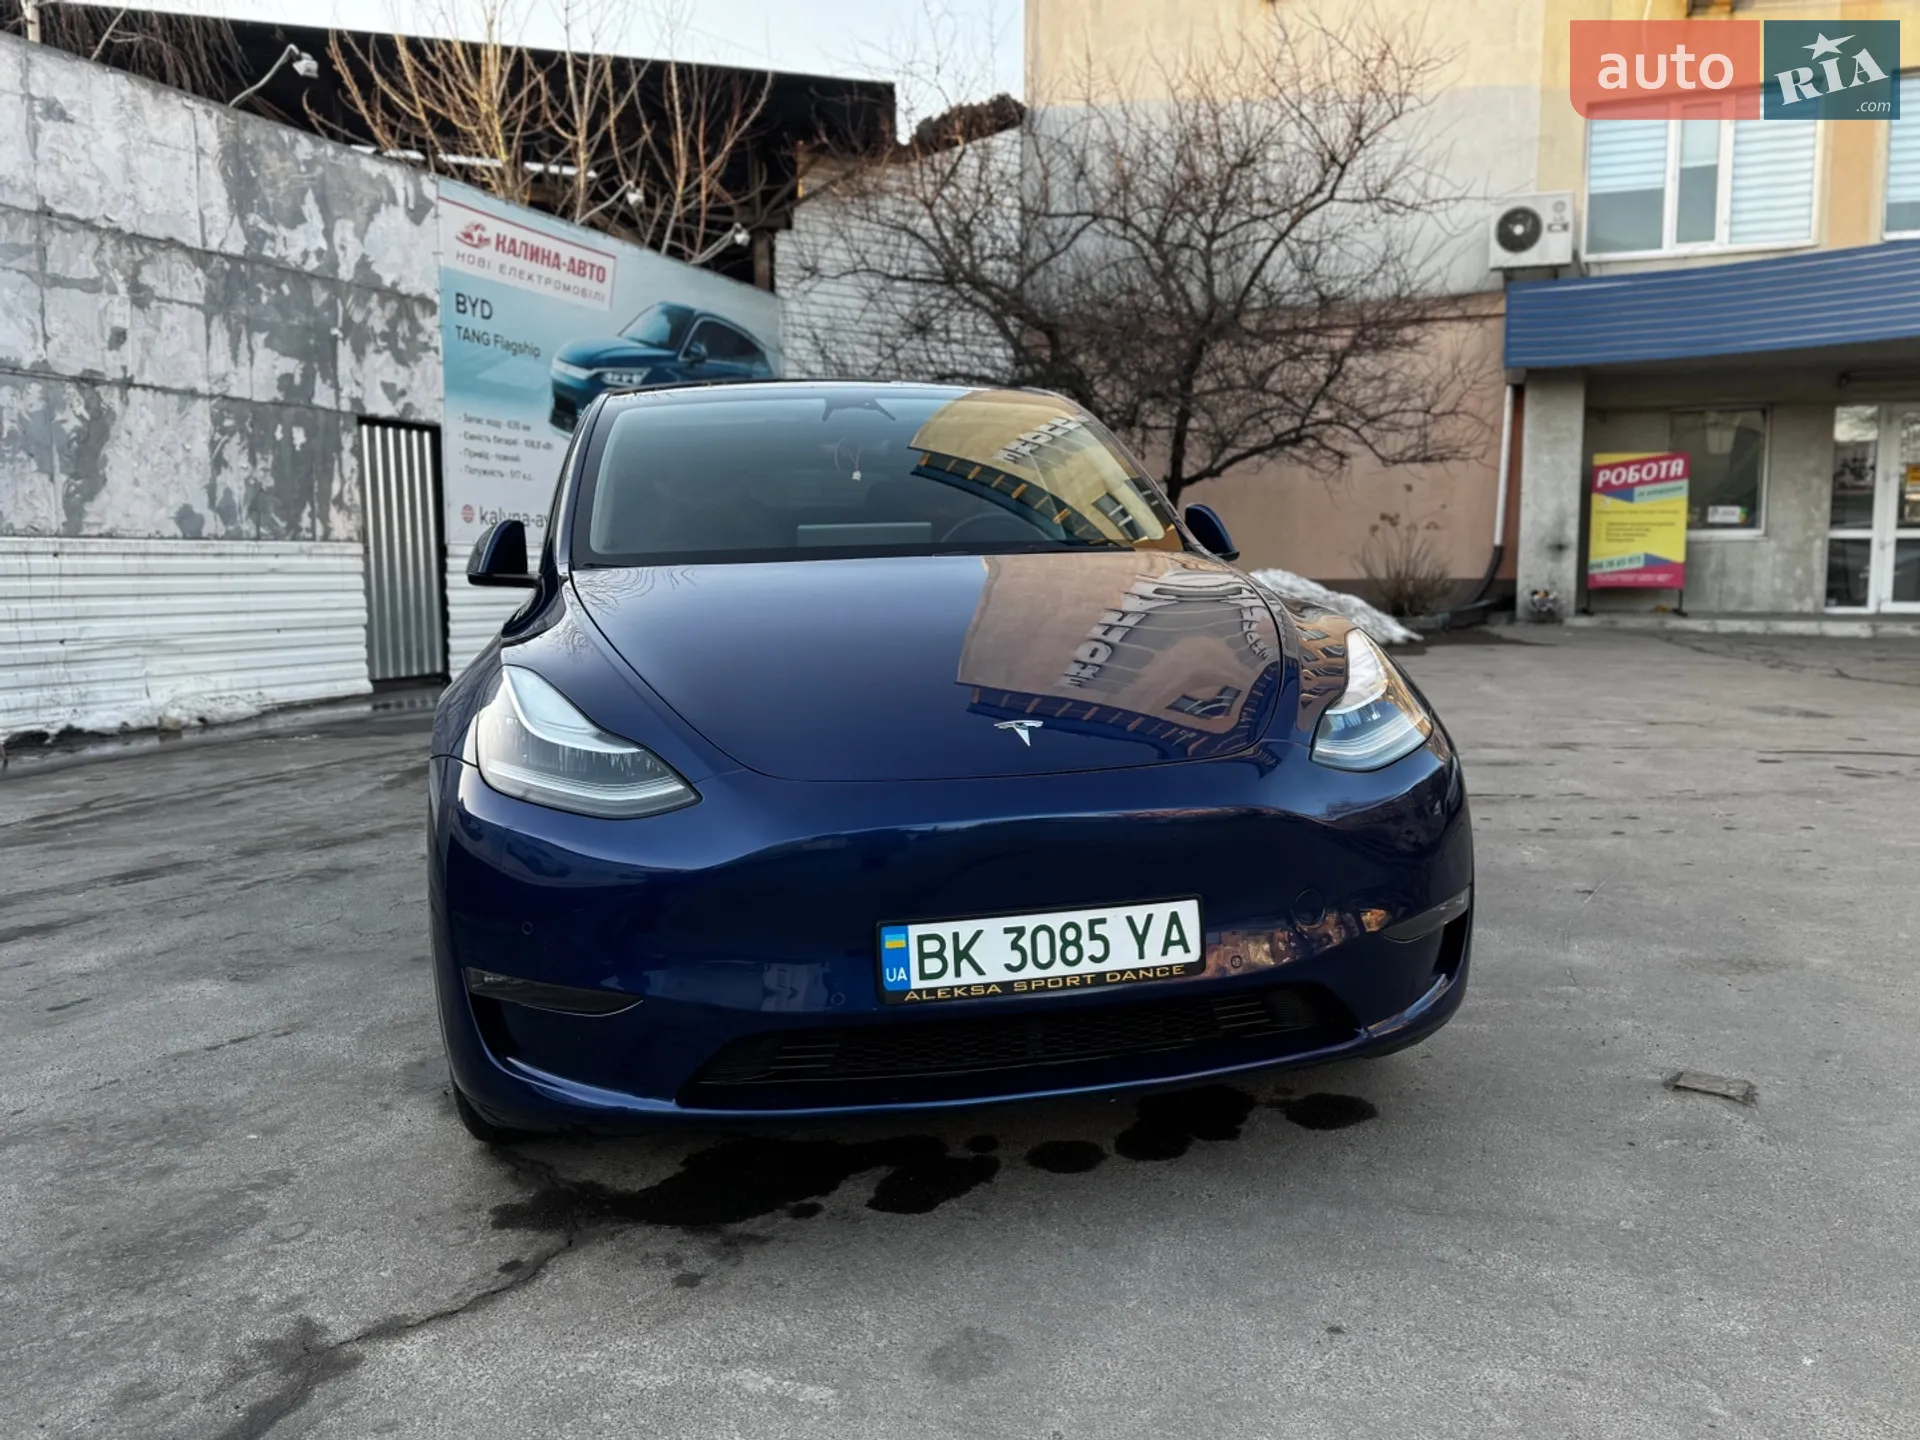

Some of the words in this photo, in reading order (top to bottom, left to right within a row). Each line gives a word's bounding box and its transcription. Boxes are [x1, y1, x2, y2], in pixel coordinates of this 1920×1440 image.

[495, 232, 607, 284] КАЛИНА-АВТО
[456, 251, 492, 270] НОВІ
[498, 263, 606, 303] ЕЛЕКТРОМОБІЛІ
[455, 291, 493, 320] BYD
[455, 325, 490, 347] TANG
[493, 333, 542, 359] Flagship
[1597, 457, 1685, 488] РОБОТА
[916, 929, 987, 981] BK
[1003, 917, 1110, 973] 3085
[1125, 910, 1191, 960] YA
[886, 968, 908, 982] UA
[904, 984, 1002, 1002] ALEKSA
[1013, 974, 1097, 992] SPORT
[1105, 965, 1186, 984] DANCE
